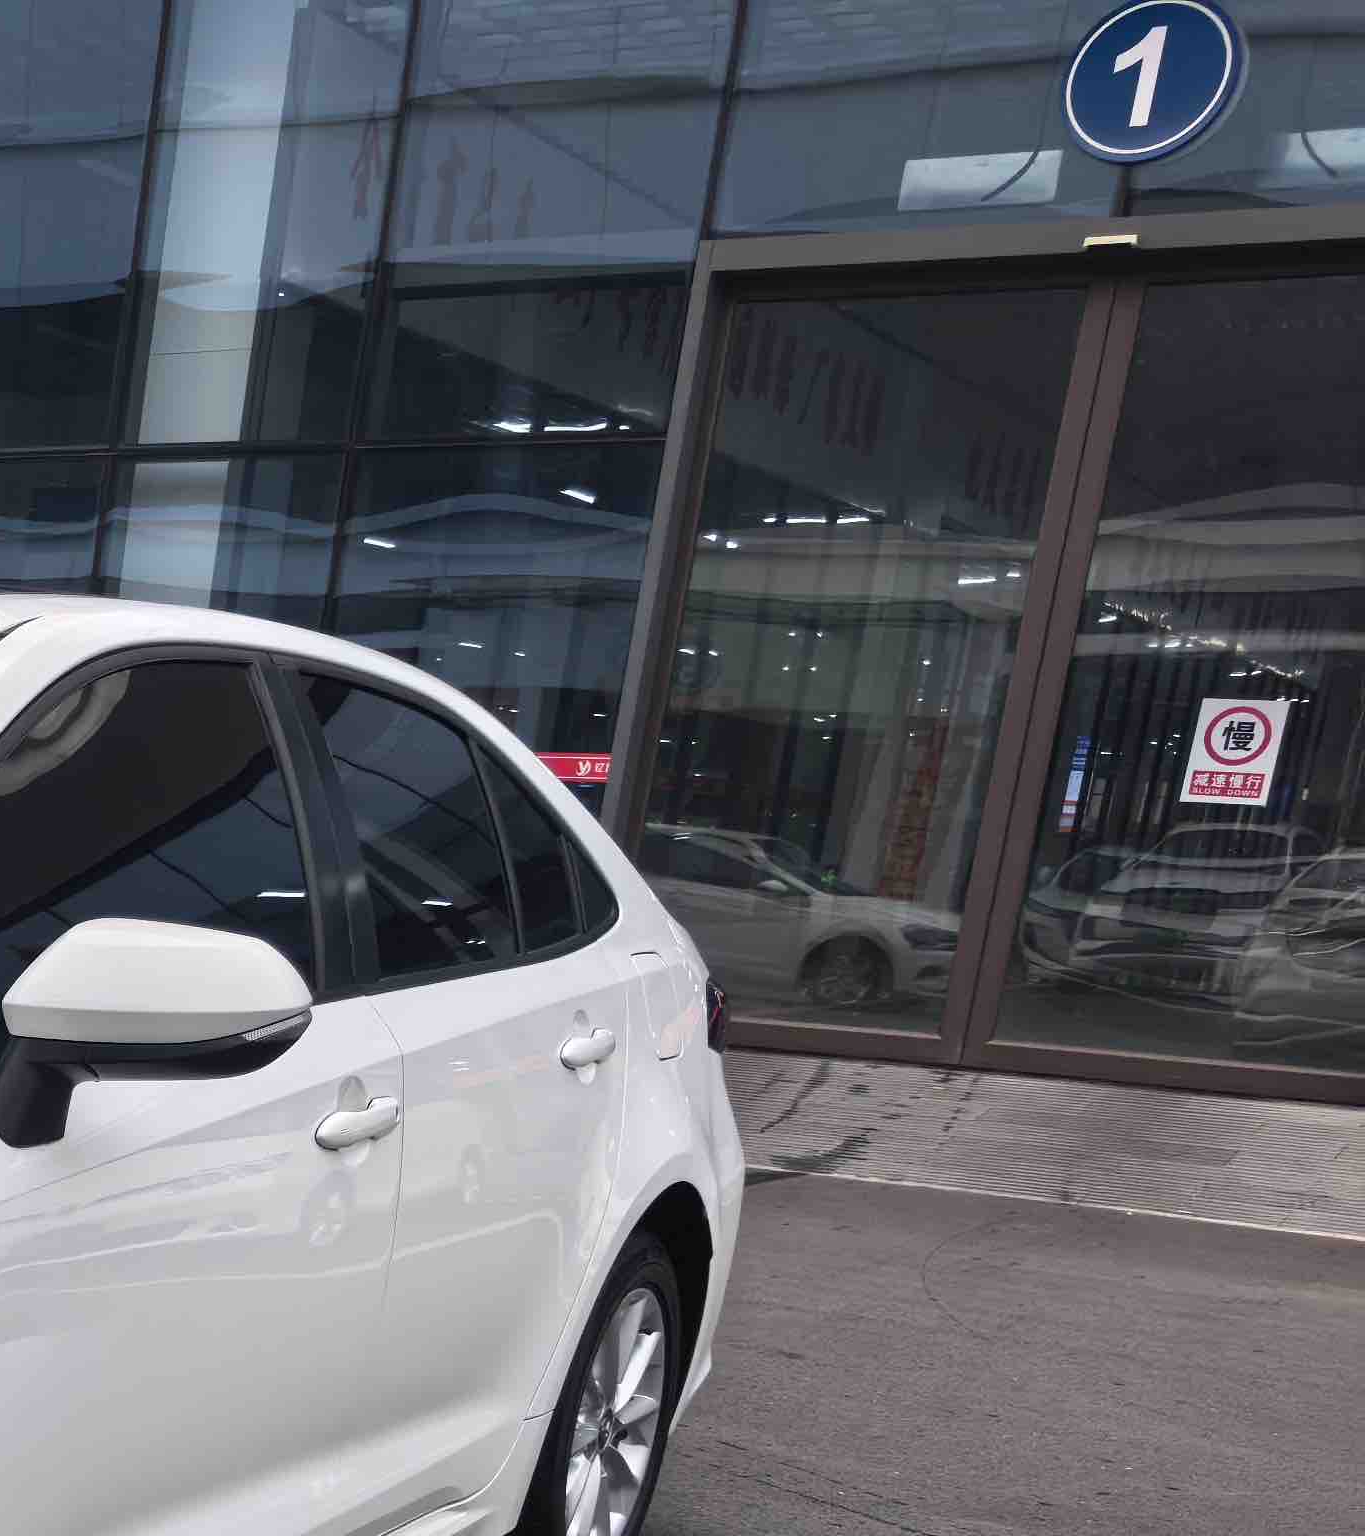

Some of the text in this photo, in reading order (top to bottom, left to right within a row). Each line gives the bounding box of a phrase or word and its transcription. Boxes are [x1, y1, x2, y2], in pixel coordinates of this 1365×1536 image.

[1112, 25, 1169, 127] 1
[1221, 720, 1257, 752] 慢
[1226, 787, 1260, 798] DOWN
